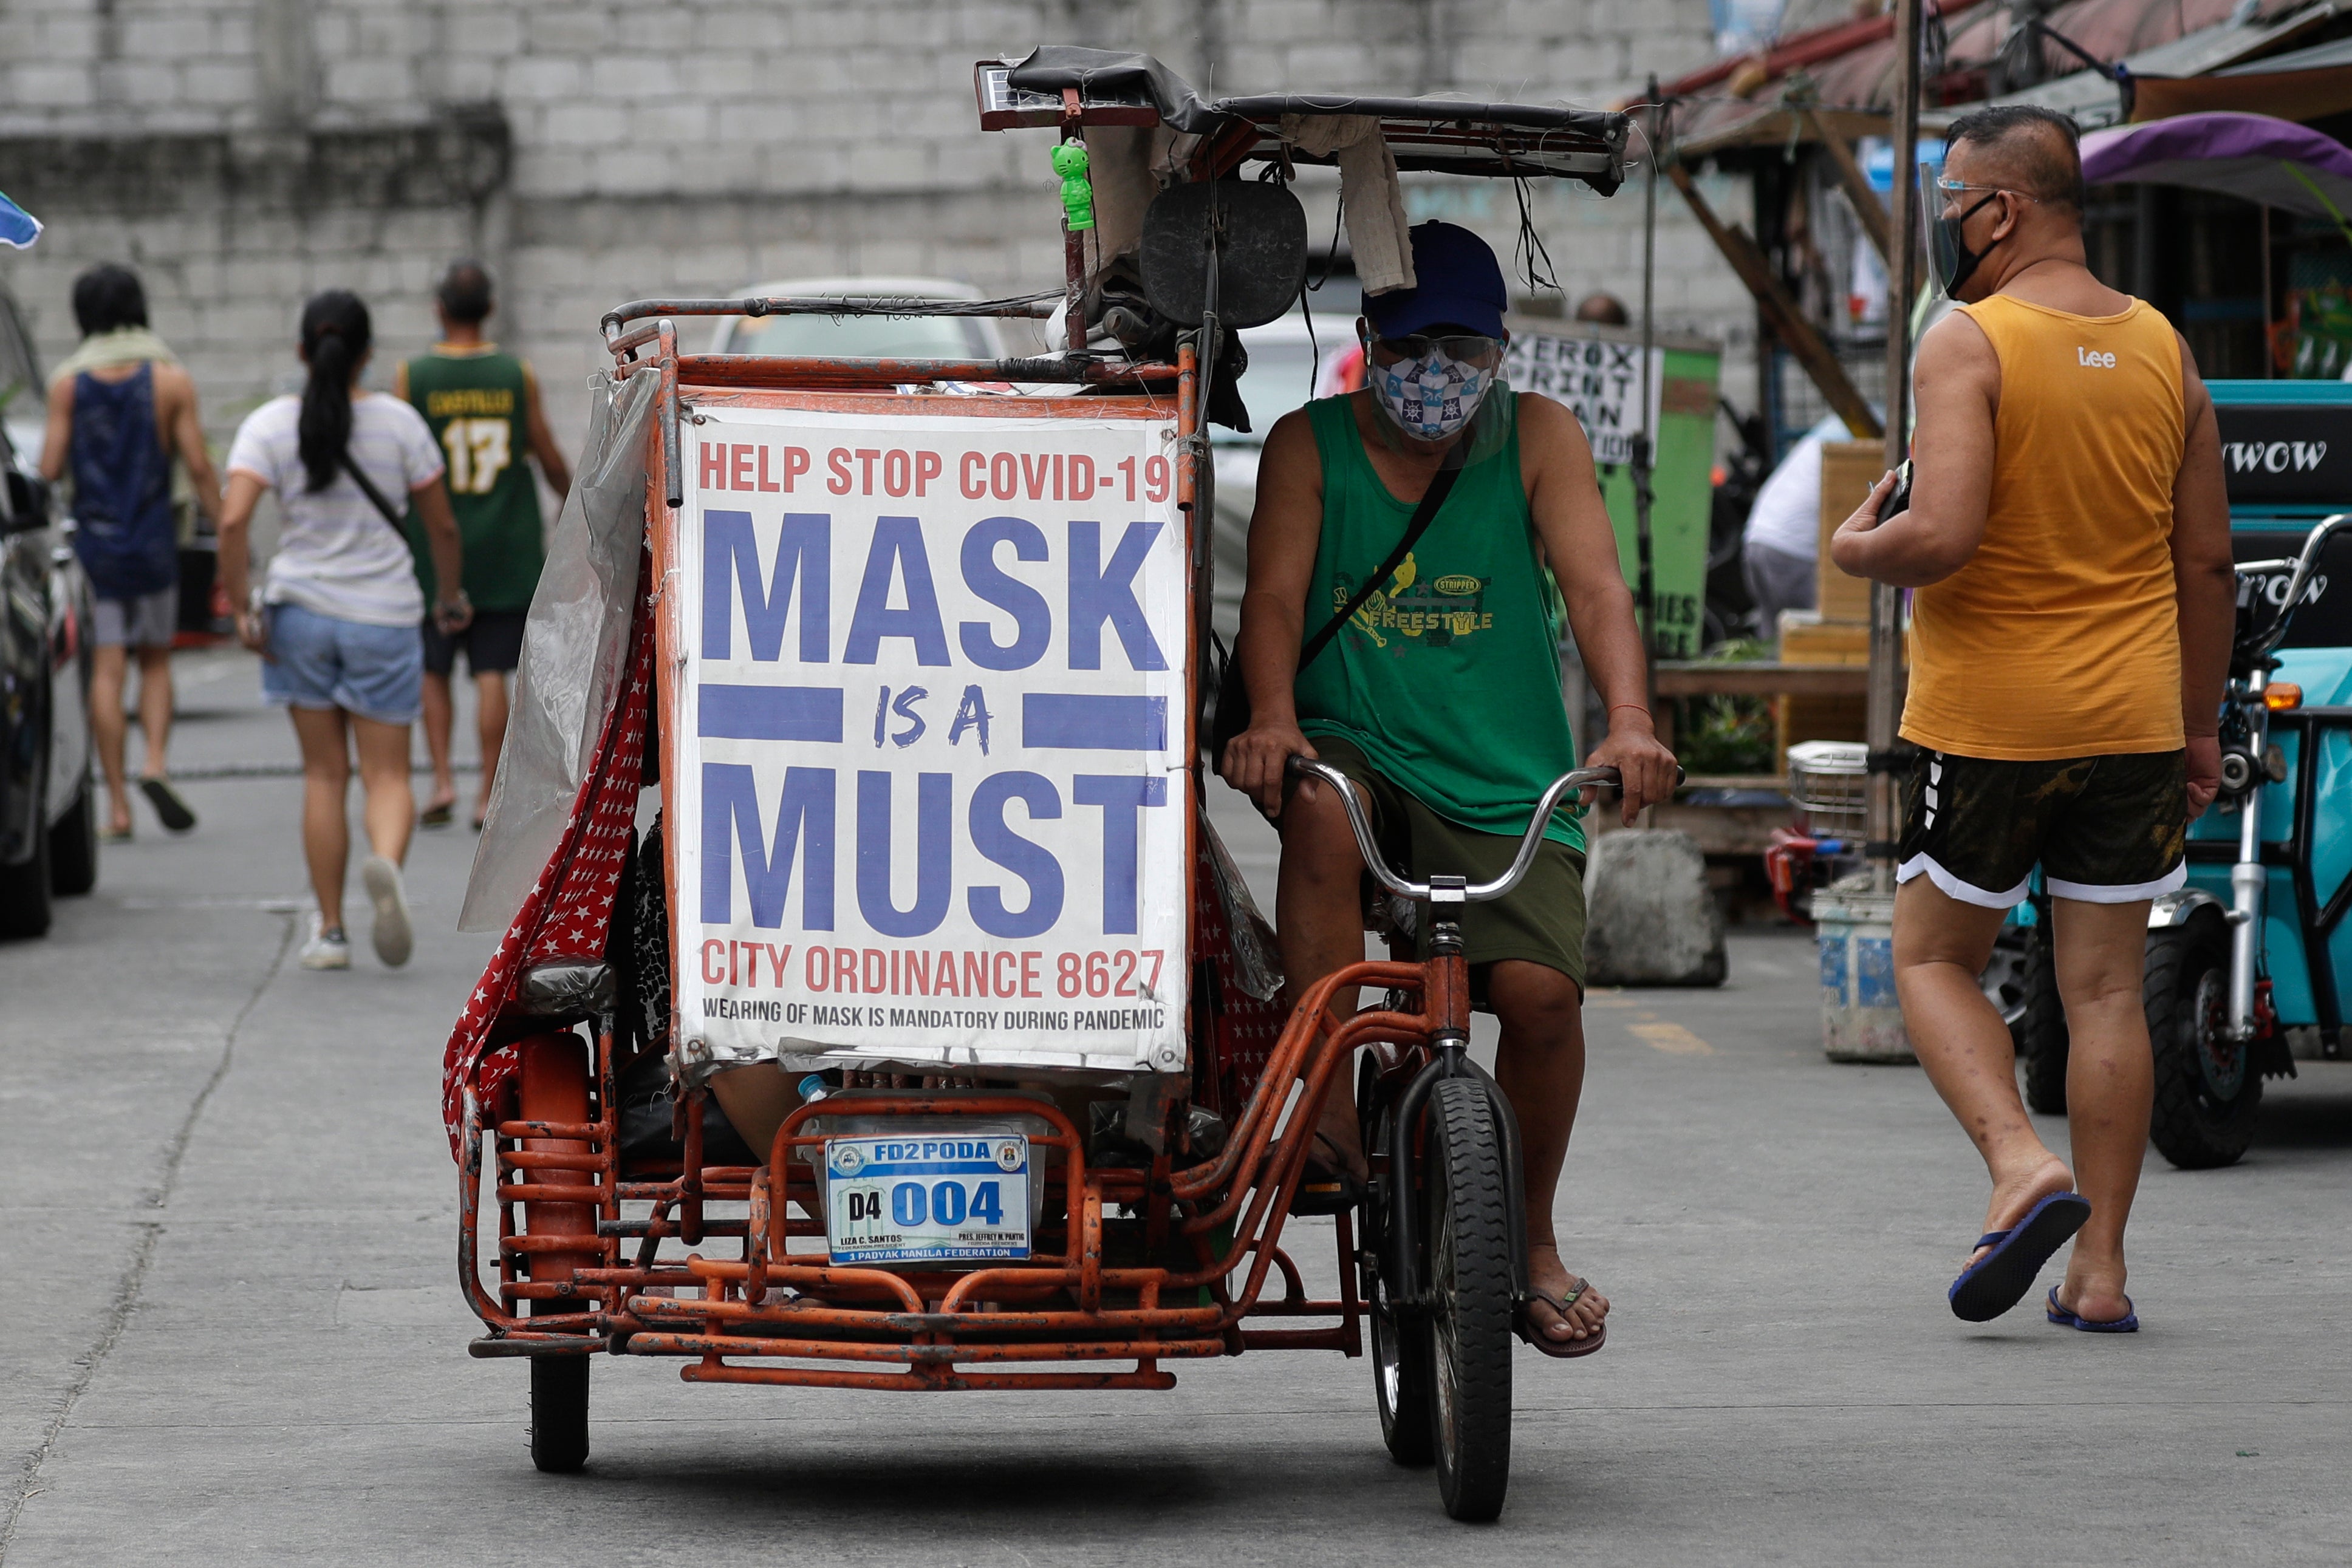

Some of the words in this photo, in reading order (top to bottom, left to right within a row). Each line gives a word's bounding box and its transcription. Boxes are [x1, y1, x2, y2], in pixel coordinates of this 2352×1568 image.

[2077, 346, 2116, 369] Lee
[442, 417, 511, 495] 17
[699, 441, 811, 493] HELP
[827, 447, 943, 497] STOP
[959, 452, 1171, 503] COVID-19
[2222, 440, 2327, 474] WOW
[701, 509, 1171, 672] MASK
[1440, 581, 1475, 590] STRIPPER
[1369, 610, 1493, 630] FREESTYLE
[873, 684, 930, 749] IS
[948, 684, 995, 757] A
[700, 762, 1169, 939] MUST
[702, 938, 793, 987] CITY
[805, 945, 1043, 999] ORDINANCE
[1057, 949, 1165, 999] 8627
[703, 998, 781, 1023] WEARING
[786, 1002, 808, 1024] OF
[813, 1005, 864, 1028] MASK
[868, 1007, 885, 1028] IS
[890, 1008, 999, 1031] MANDATORY
[1003, 1009, 1069, 1031] DURING
[1073, 1007, 1165, 1031] PANDEMIC
[875, 1142, 991, 1161] FD2PODA
[849, 1192, 881, 1222] D4
[892, 1181, 1004, 1227] 004
[841, 1236, 857, 1246] LIZA
[868, 1235, 903, 1243] SANTOS
[976, 1233, 997, 1241] JEFFREY
[858, 1250, 899, 1260] PADYAK
[901, 1249, 942, 1258] MANILA
